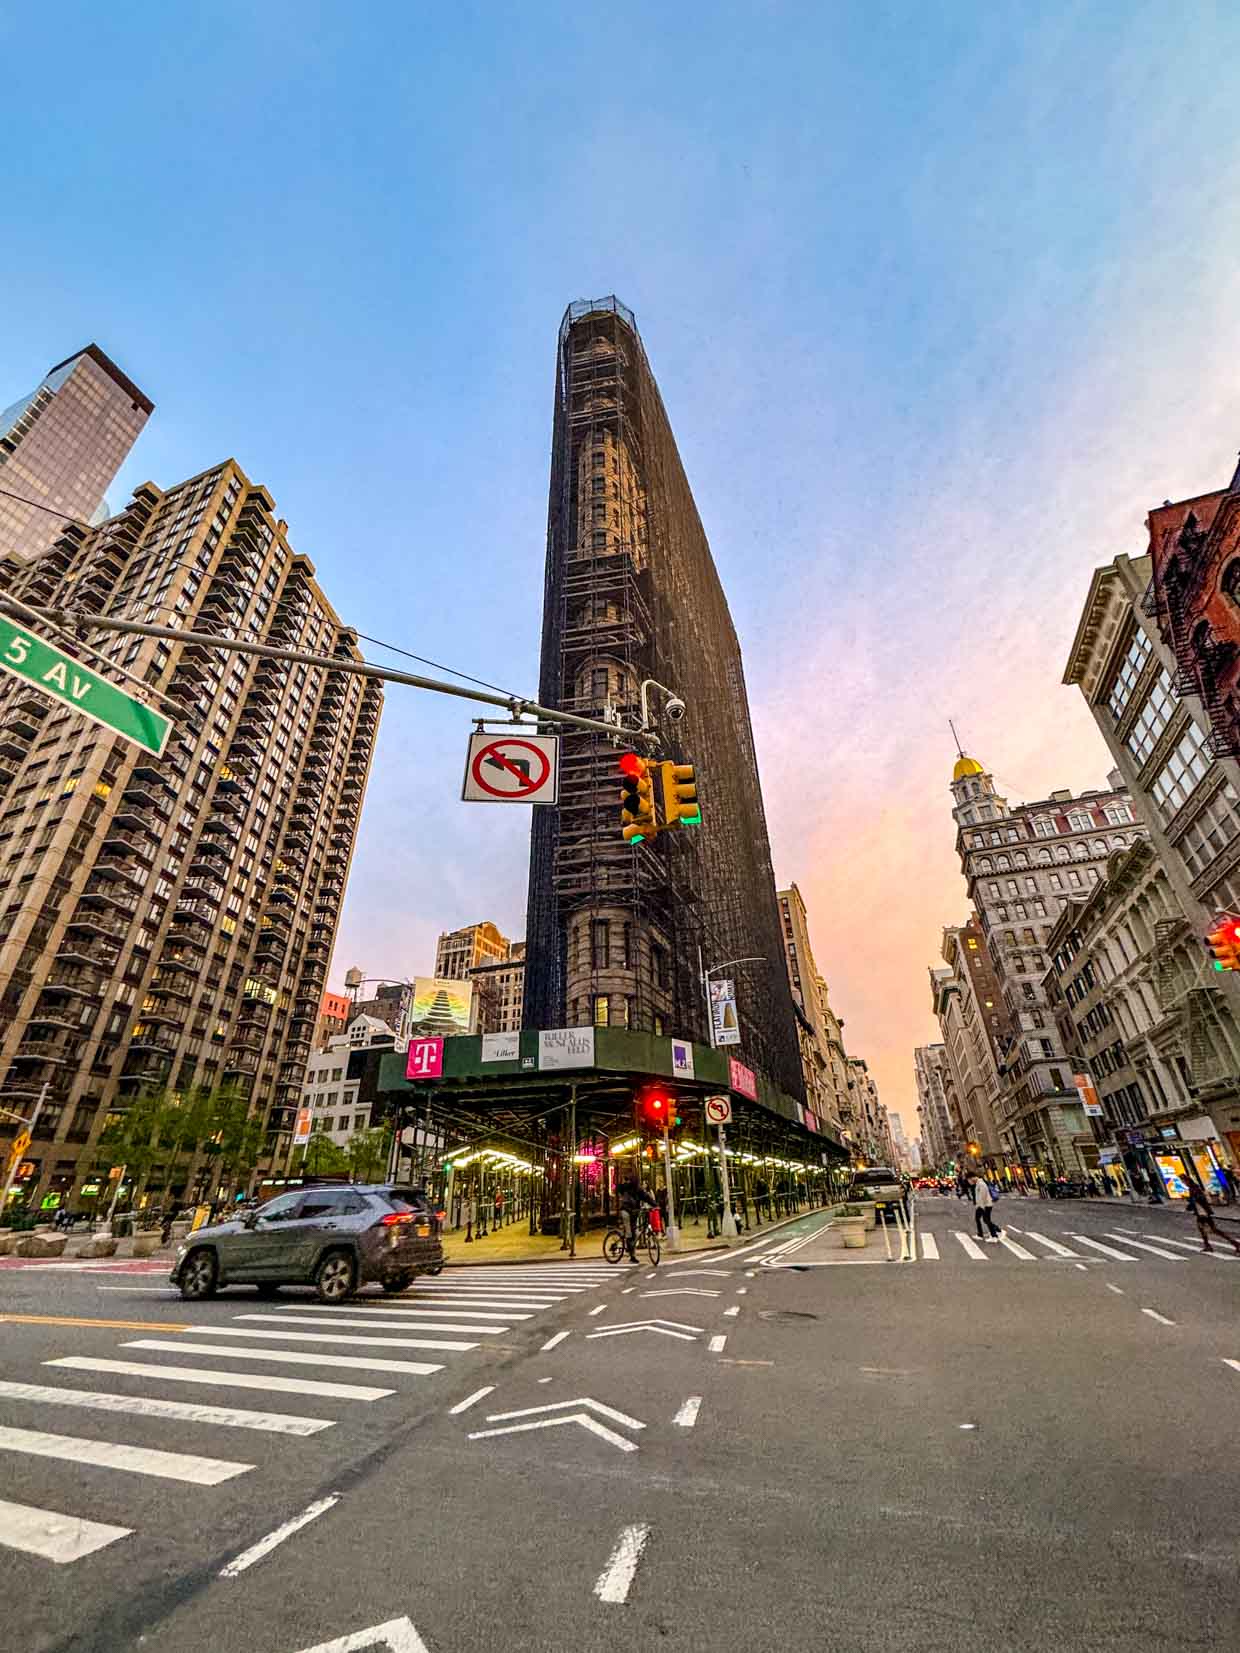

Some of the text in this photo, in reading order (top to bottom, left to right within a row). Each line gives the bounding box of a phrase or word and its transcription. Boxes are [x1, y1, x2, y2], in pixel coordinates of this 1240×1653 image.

[5, 636, 91, 699] 5 AV
[711, 1001, 721, 1029] FLATIRON
[414, 1043, 436, 1073] T
